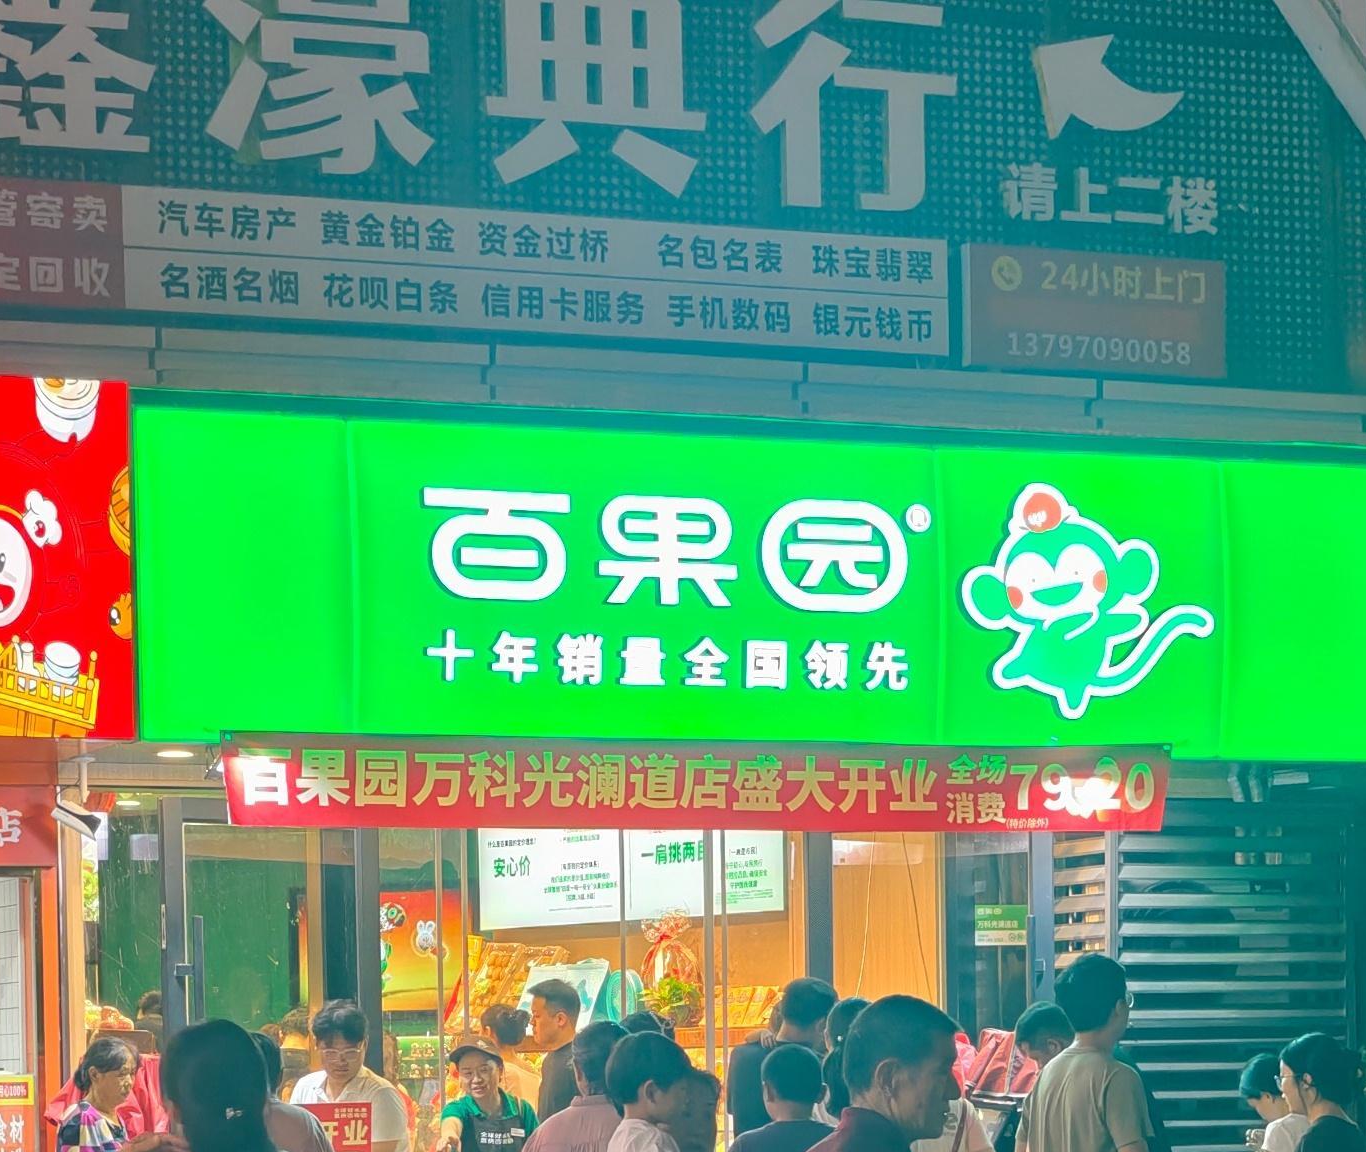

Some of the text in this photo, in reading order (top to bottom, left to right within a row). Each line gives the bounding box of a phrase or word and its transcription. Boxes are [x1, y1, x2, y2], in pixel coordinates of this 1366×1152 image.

[1002, 162, 1220, 237] 请上二楼
[157, 201, 934, 285] 汽车房产 黄金铂金 资金过桥 名包名表 珠宝翡翠
[160, 262, 933, 342] 名酒名烟 花呗白条 信用卡服务 手机数码 银元钱币
[1040, 261, 1207, 305] 24小时上门
[1007, 331, 1191, 367] 13797090058
[422, 485, 908, 614] 百果园
[425, 629, 909, 693] 十年销量全国领先
[238, 746, 938, 818] 百果园万科光澜道店盛大开业
[947, 754, 1007, 785] 全场
[947, 792, 1006, 824] 消费
[493, 856, 530, 878] 安心价
